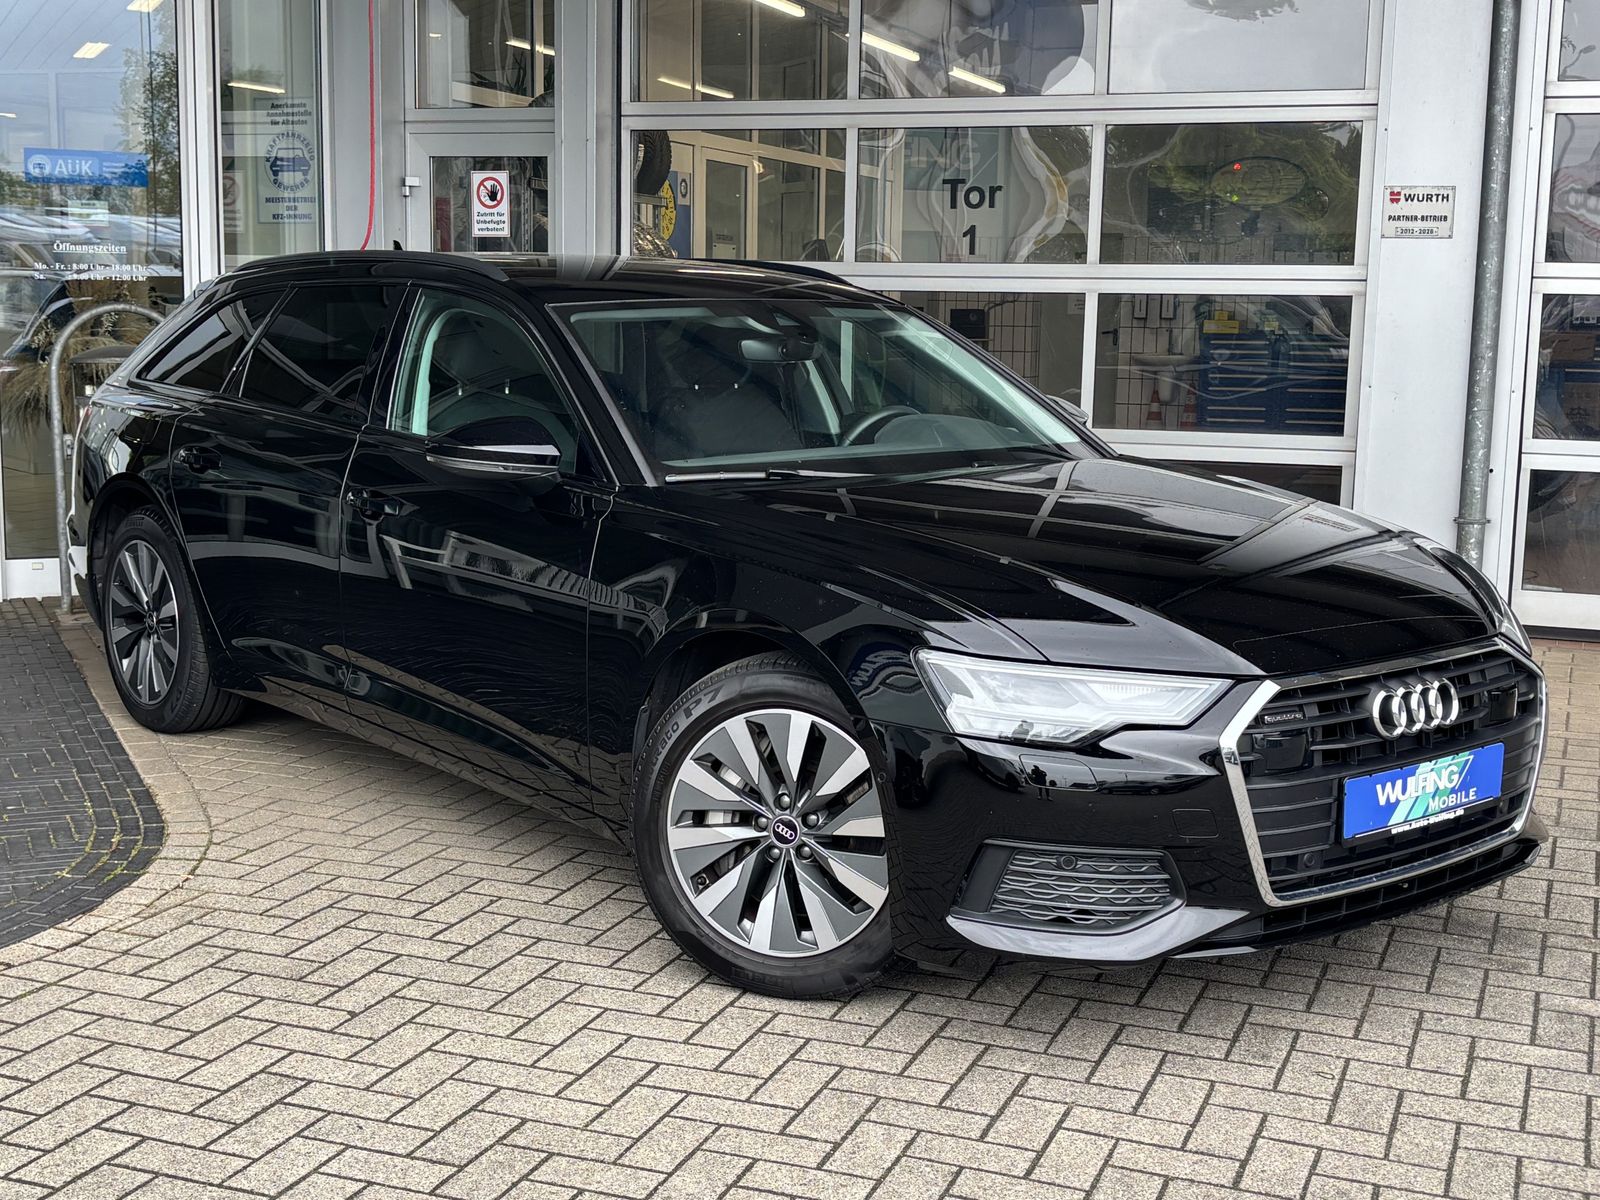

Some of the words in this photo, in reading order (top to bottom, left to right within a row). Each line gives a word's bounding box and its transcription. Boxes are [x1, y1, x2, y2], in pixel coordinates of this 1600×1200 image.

[265, 196, 316, 204] MEISTERBETRIE
[942, 178, 1004, 210] Tor
[53, 240, 127, 254] Öffnungszeiten
[962, 224, 977, 256] 1
[34, 262, 49, 270] Mo.
[132, 264, 147, 272] Uhr
[34, 272, 47, 280] Sa.
[132, 274, 147, 282] Uhr
[683, 683, 727, 720] P7
[1428, 787, 1478, 813] MOBILE
